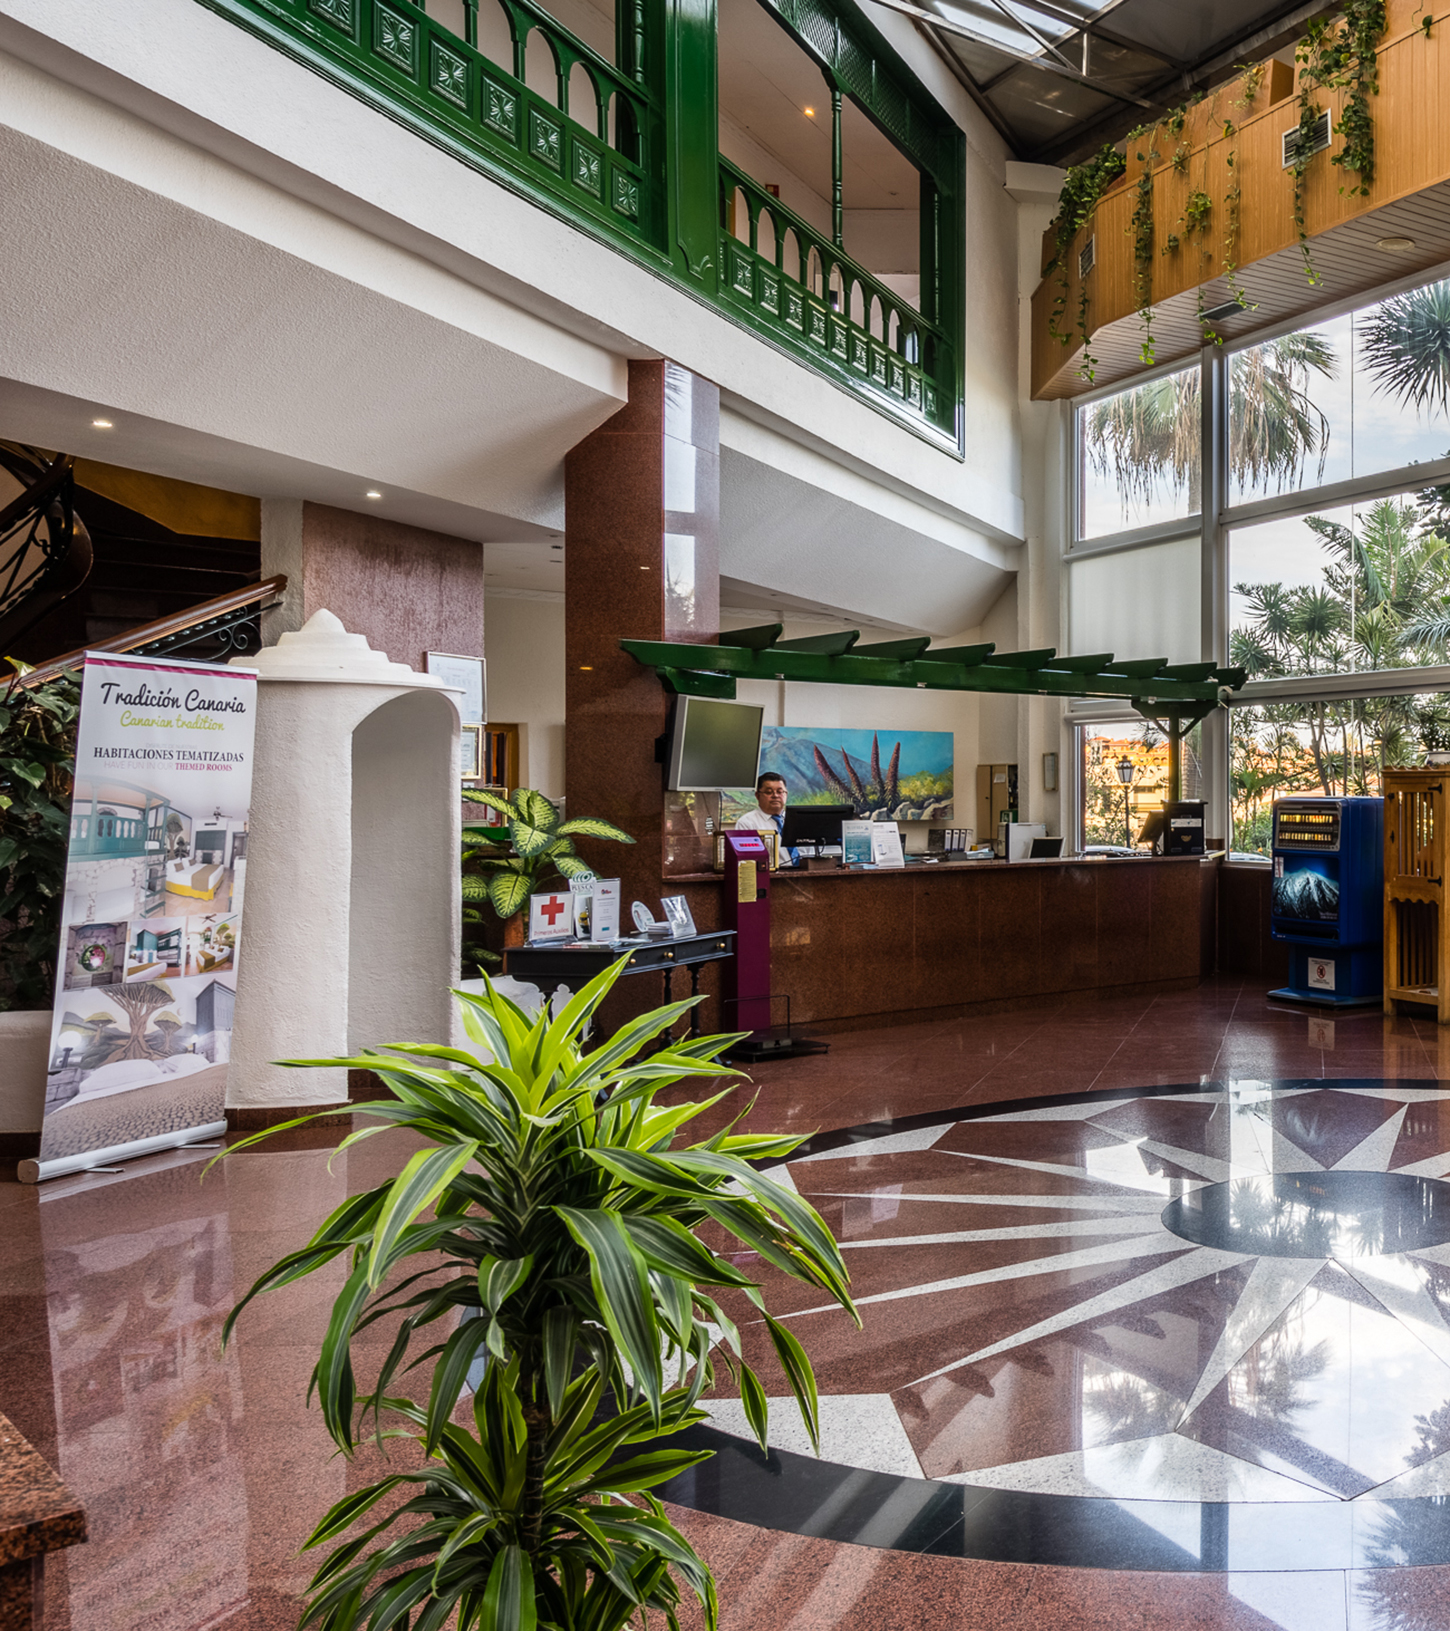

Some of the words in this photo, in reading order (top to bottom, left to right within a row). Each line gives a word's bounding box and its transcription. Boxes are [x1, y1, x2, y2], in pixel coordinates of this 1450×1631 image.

[101, 682, 181, 709] Tradición
[185, 689, 246, 713] Canaria
[120, 710, 173, 728] Canarian
[175, 714, 225, 731] tradition
[94, 747, 173, 760] HABITACIONES
[176, 750, 244, 762] TEMATIZADAS
[104, 760, 125, 769] HAVE
[128, 761, 144, 770] FUN
[147, 761, 155, 770] IN
[157, 762, 173, 770] OUR
[175, 763, 205, 771] THEMED
